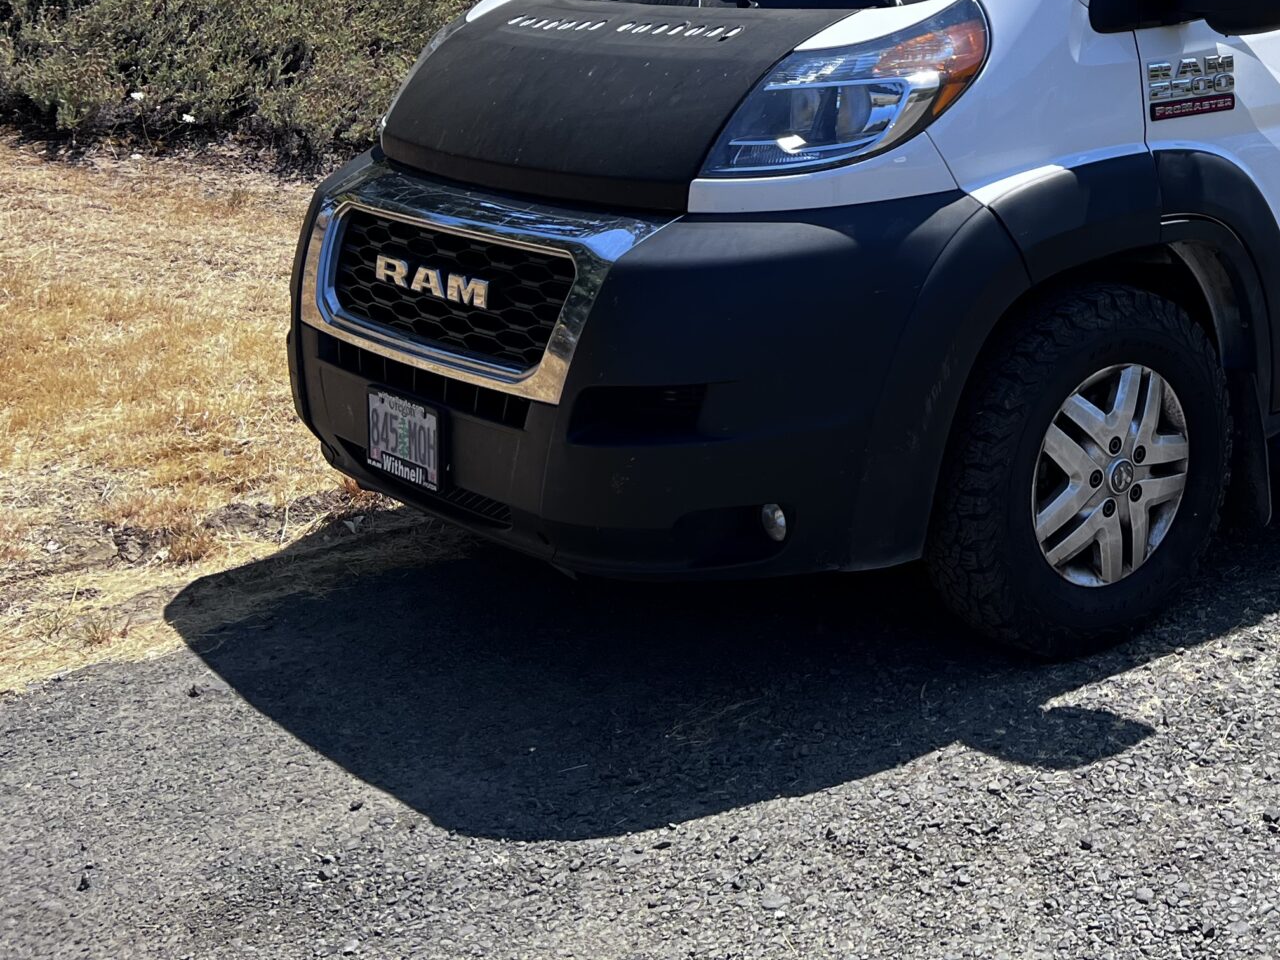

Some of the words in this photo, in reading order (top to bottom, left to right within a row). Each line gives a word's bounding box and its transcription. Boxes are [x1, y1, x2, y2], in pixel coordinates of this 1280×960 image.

[1148, 54, 1234, 81] RAM
[1149, 73, 1234, 100] 2500
[375, 254, 489, 309] RAM
[389, 400, 416, 418] Oregon
[371, 408, 399, 454] 845
[382, 453, 423, 485] Withnell
